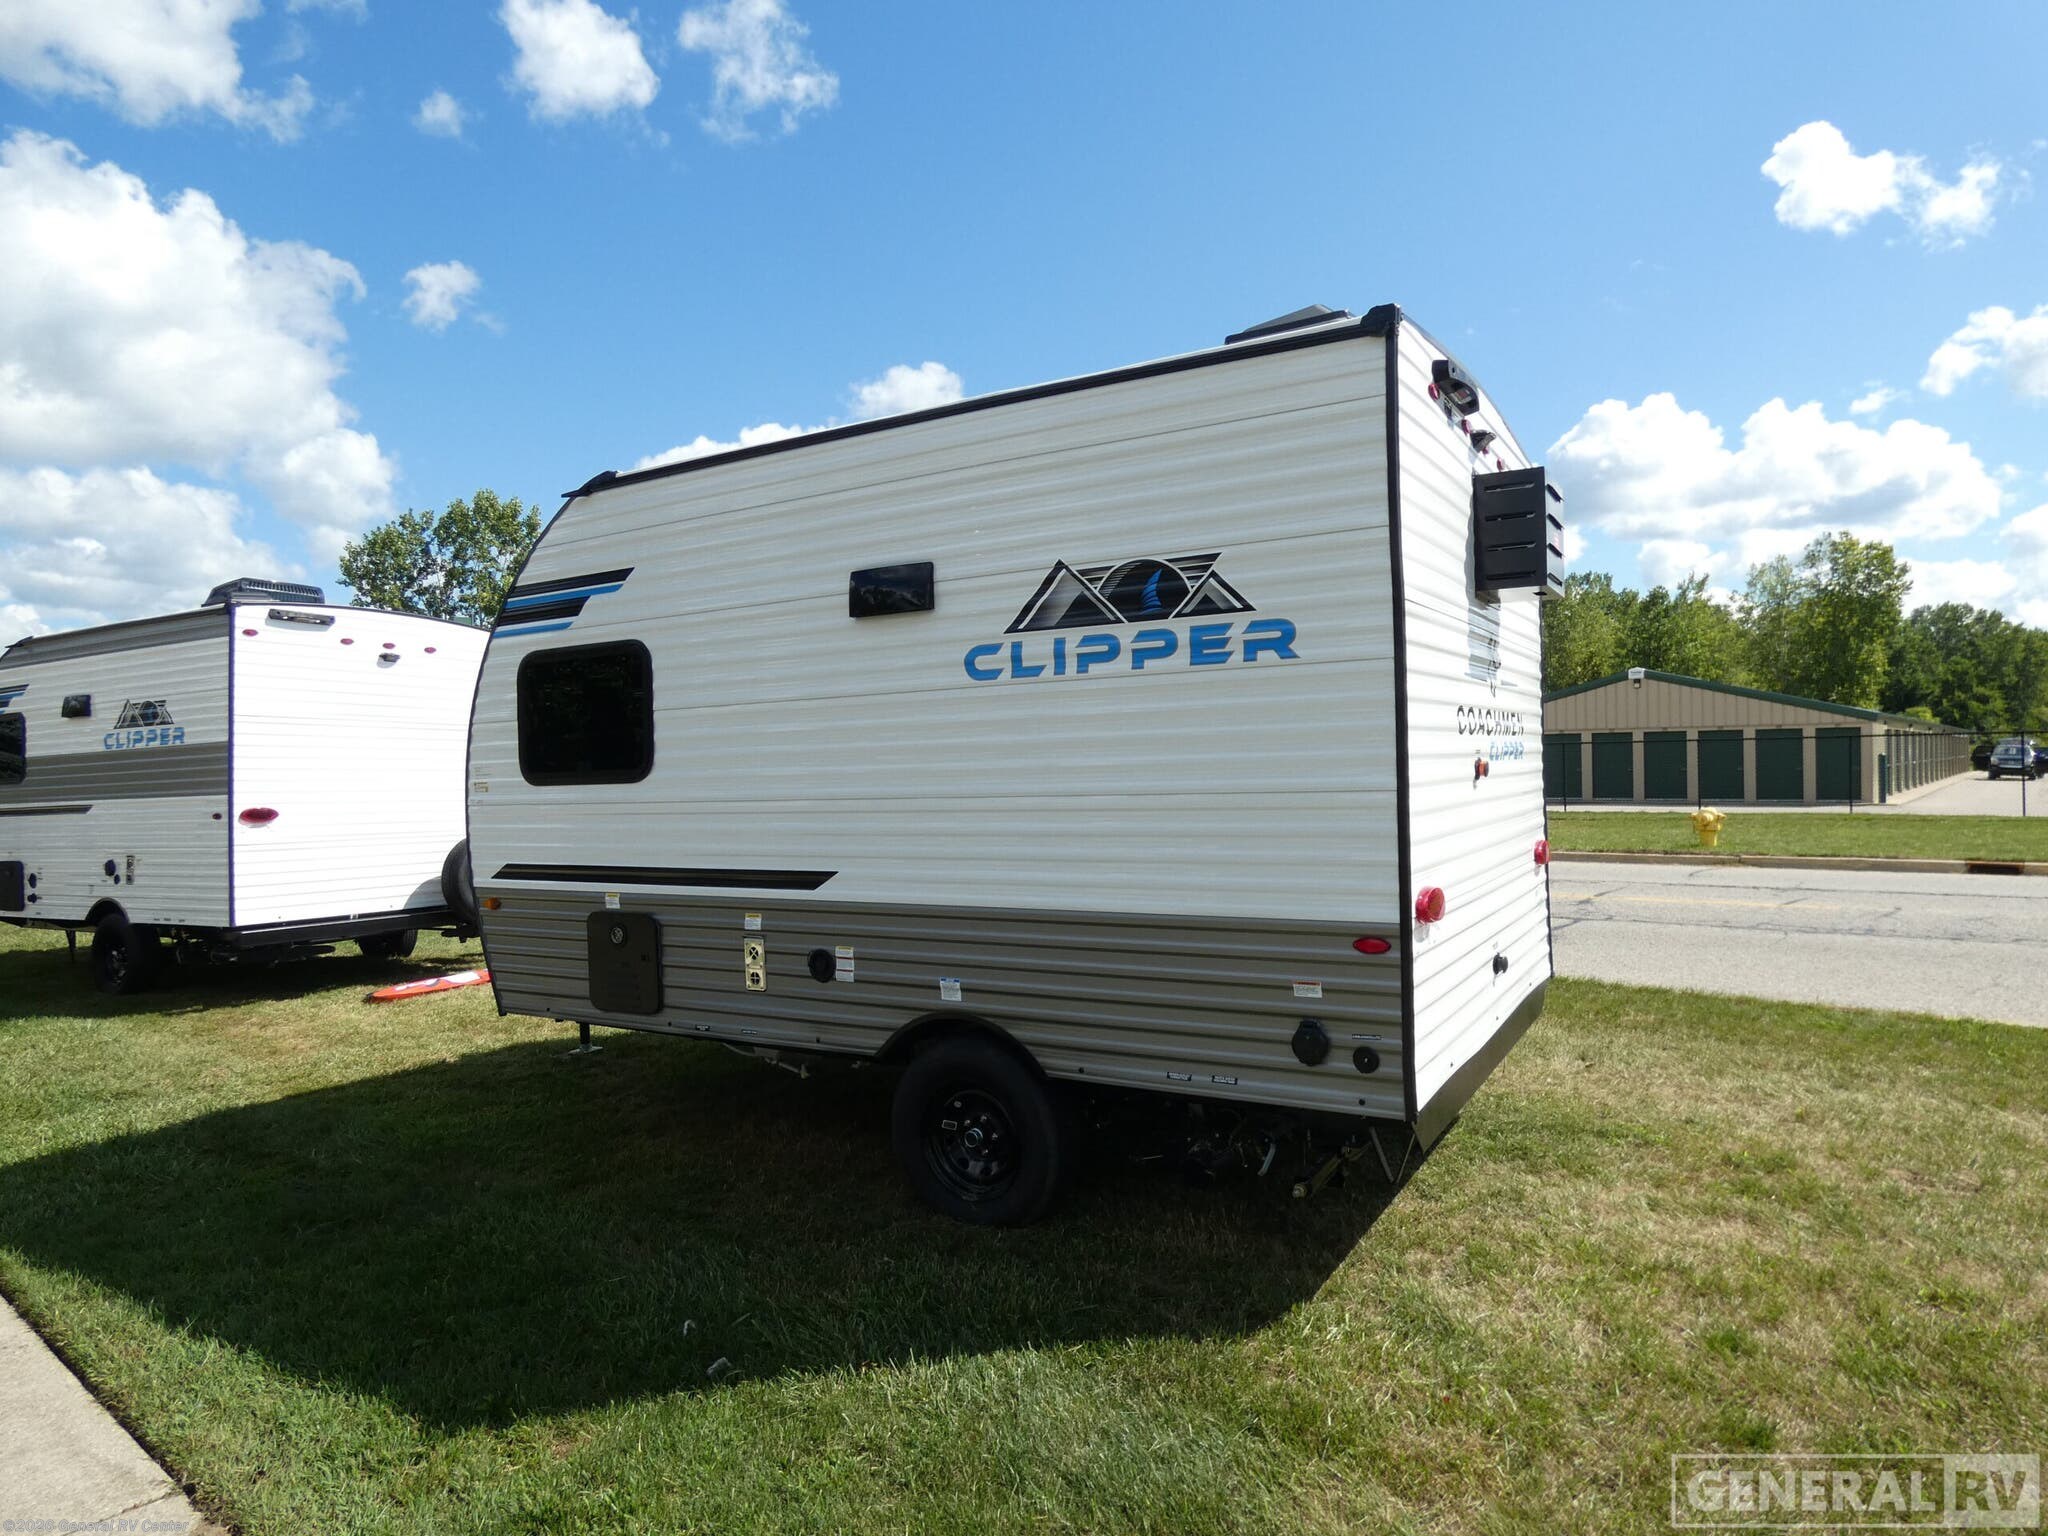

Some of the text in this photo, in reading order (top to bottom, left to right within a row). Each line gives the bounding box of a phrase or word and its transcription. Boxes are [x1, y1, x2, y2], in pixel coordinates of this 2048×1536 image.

[963, 617, 1301, 682] CLIPPER
[1456, 705, 1525, 736] COACHMEN
[103, 727, 185, 749] CLIPPER
[1489, 741, 1525, 761] CLIPPER
